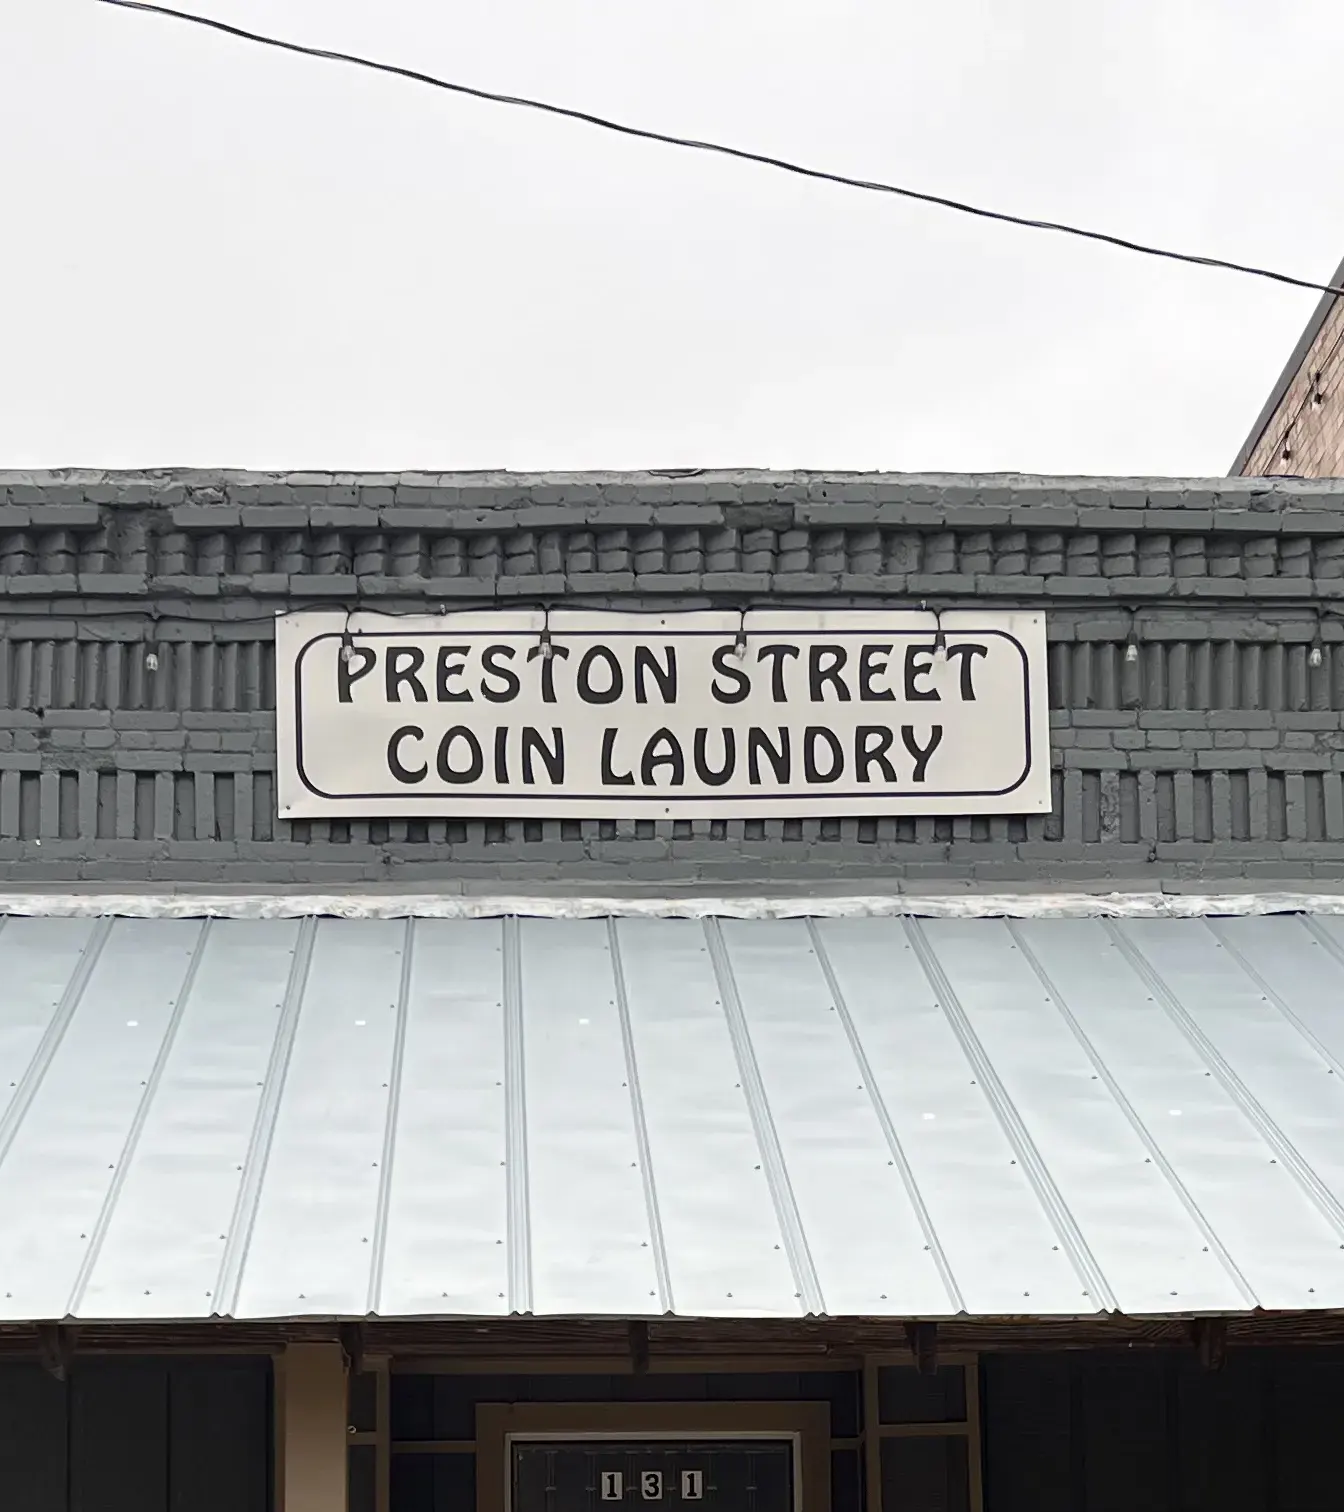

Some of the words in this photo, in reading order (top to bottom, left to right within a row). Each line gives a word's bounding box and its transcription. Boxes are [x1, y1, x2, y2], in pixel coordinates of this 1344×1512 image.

[337, 644, 678, 704] PRESTON
[712, 643, 988, 703] STREET
[387, 725, 564, 785] COIN
[602, 724, 943, 786] LAUNDRY
[604, 1472, 700, 1499] 131
